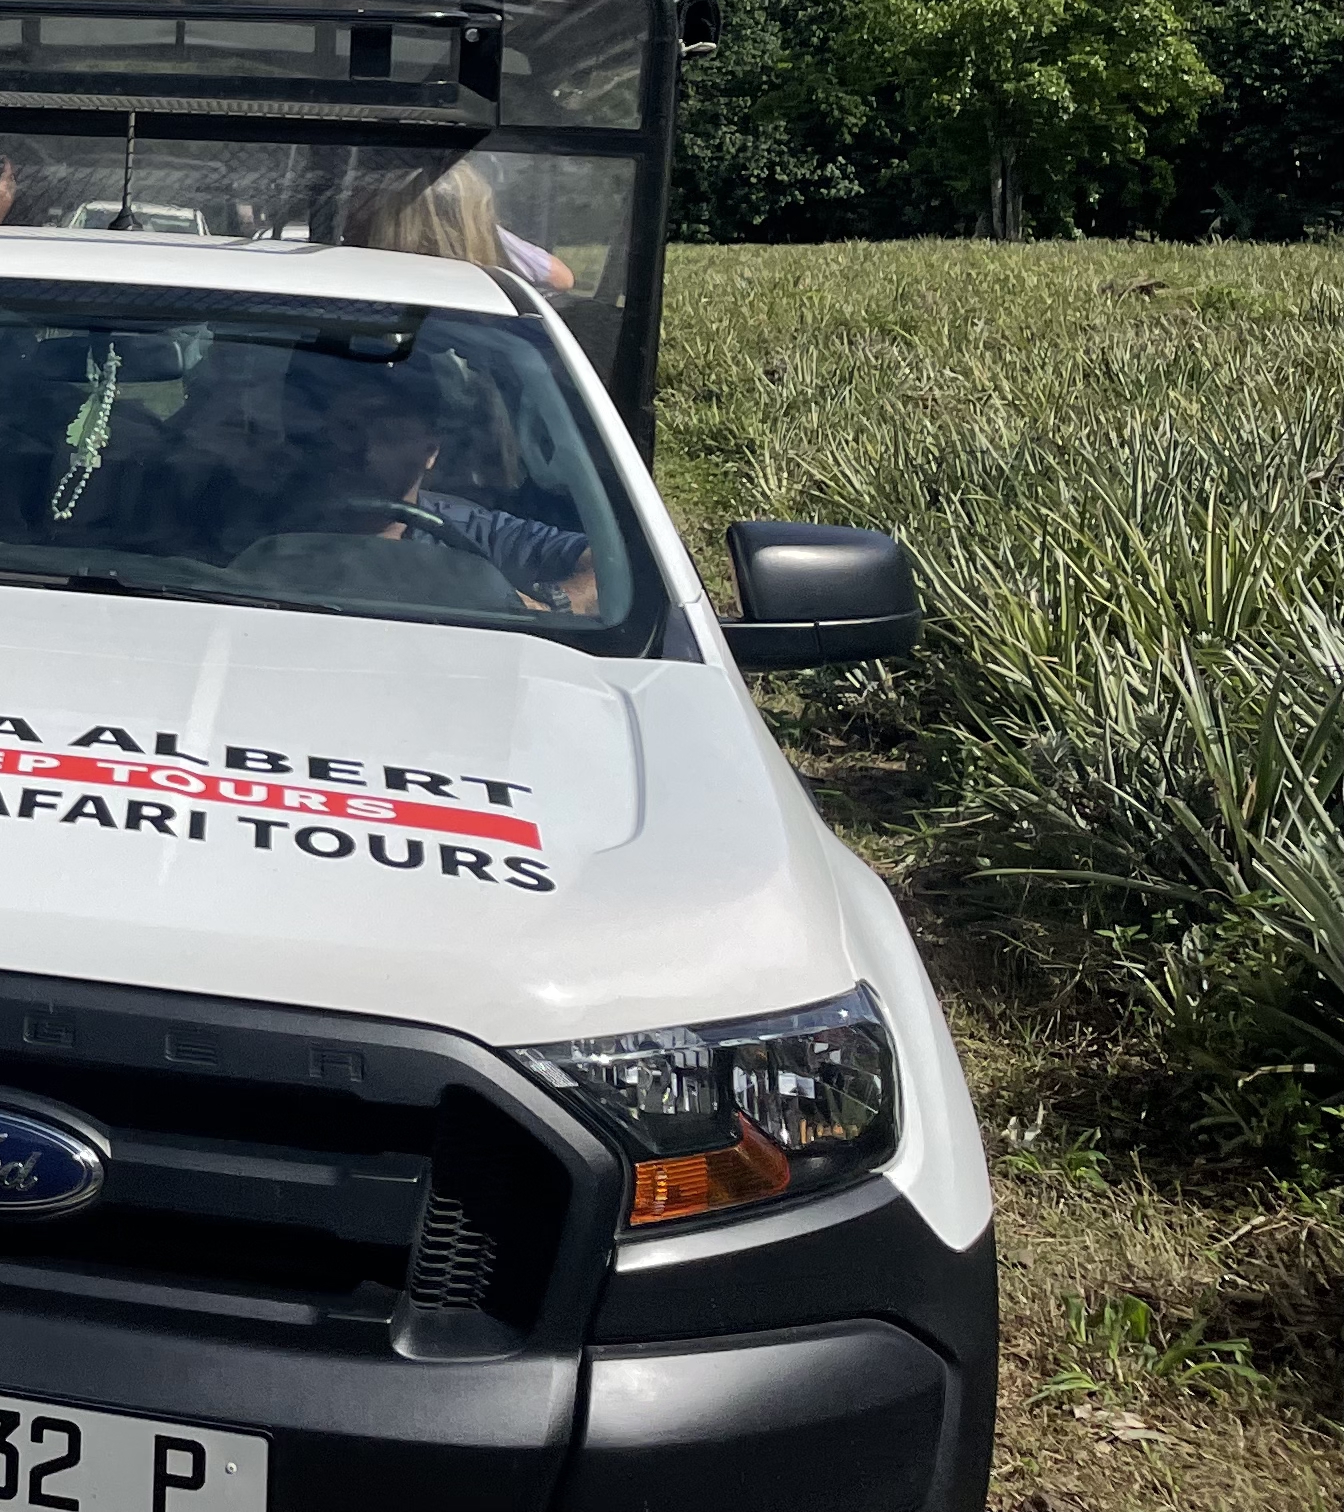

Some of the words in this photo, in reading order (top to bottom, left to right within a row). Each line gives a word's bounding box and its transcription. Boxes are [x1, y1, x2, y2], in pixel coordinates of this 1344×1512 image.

[67, 724, 533, 808] ALBERT
[95, 760, 398, 820] TOURS
[237, 815, 558, 894] TOURS
[152, 1433, 207, 1512] P
